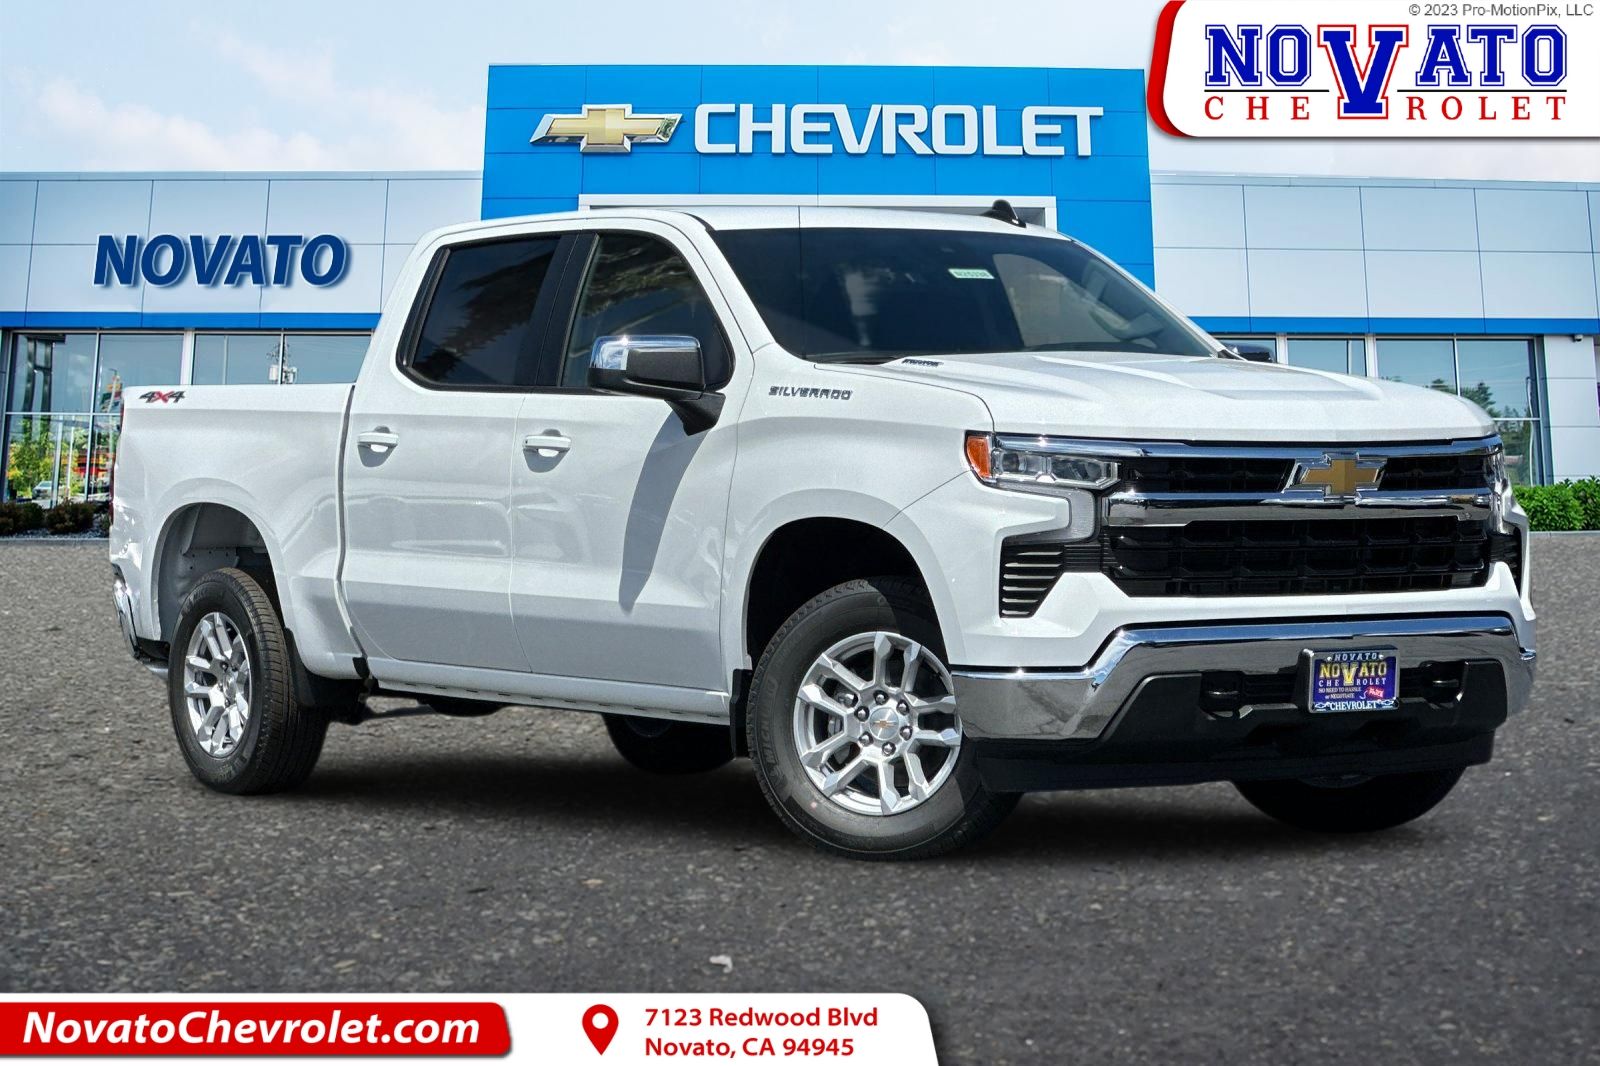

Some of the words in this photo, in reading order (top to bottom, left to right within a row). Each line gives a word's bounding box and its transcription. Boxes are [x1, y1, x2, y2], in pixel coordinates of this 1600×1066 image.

[694, 103, 1104, 157] CHEVROLET
[93, 233, 349, 287] NOVATO
[768, 386, 853, 400] SILVERADO
[1334, 652, 1377, 661] NOVATO
[1319, 662, 1387, 685] NOVATO
[1330, 701, 1377, 710] CHEVROLET
